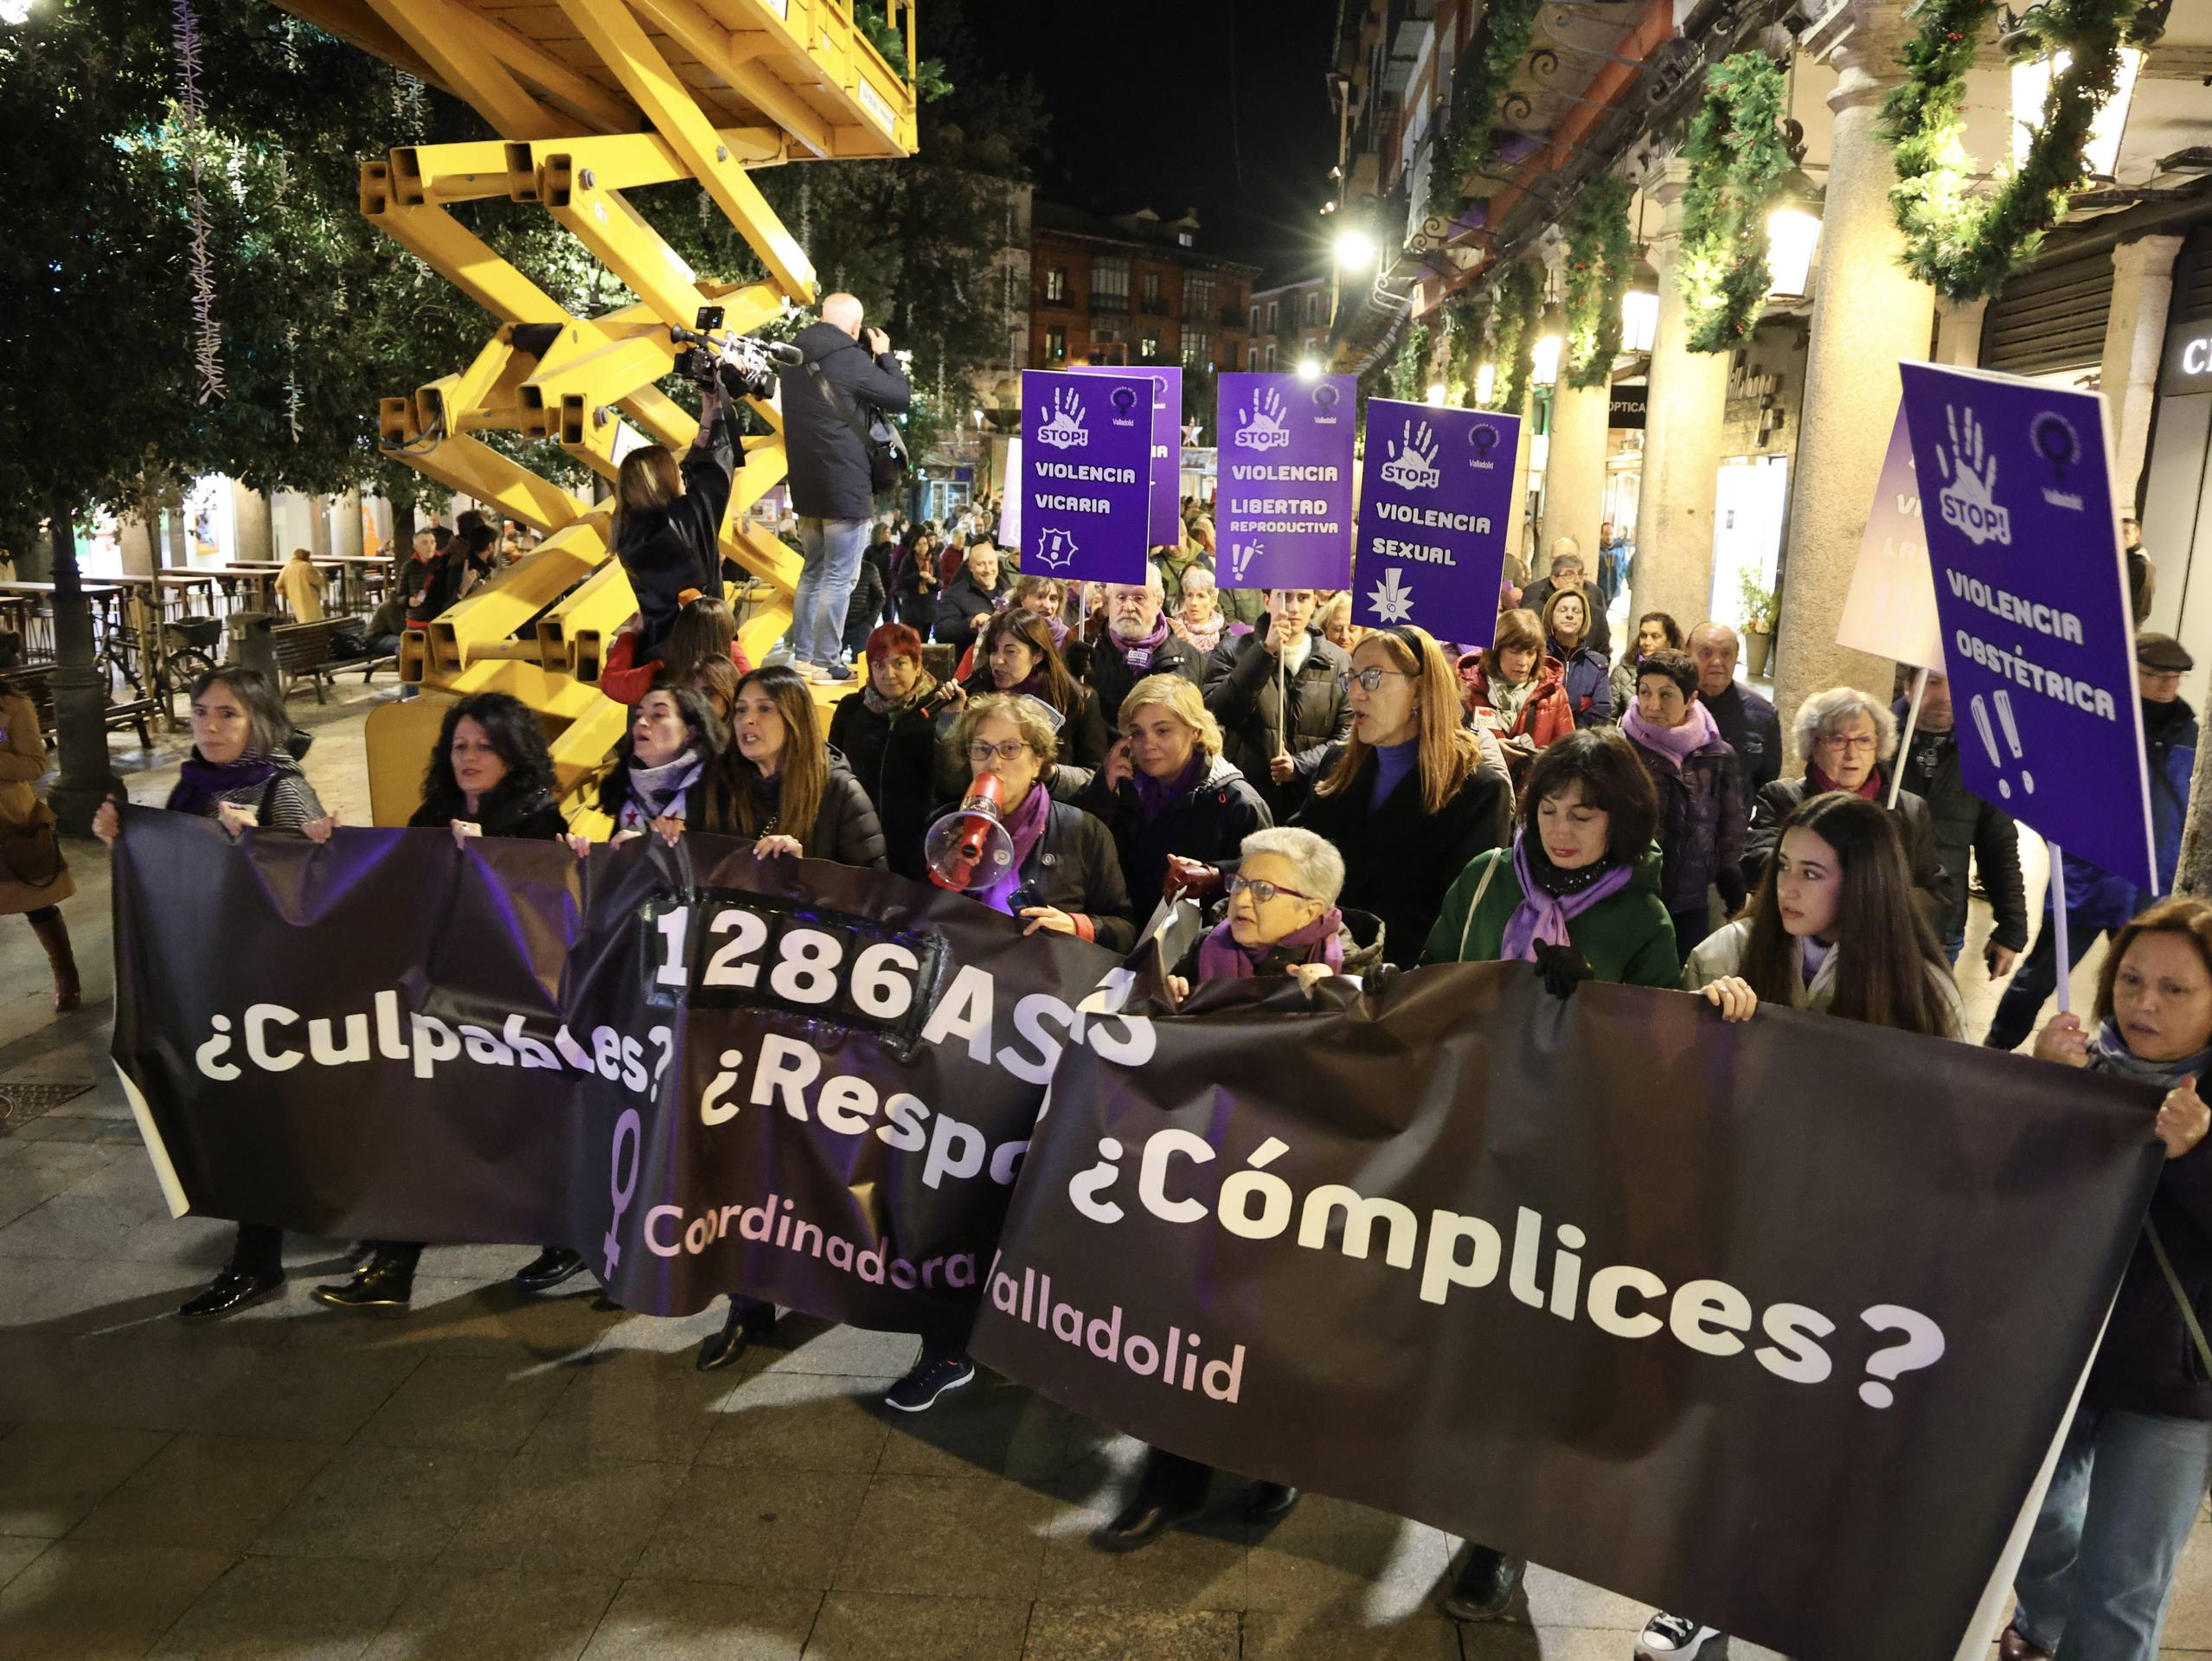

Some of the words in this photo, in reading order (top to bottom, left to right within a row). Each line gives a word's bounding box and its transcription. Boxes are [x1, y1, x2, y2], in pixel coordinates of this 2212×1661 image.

[1041, 429, 1086, 443] STOP!
[1238, 432, 1286, 444] STOP!
[1035, 462, 1136, 484] VIOLENCIA
[1232, 465, 1337, 482] VIOLENCIA
[1384, 465, 1437, 485] STOP!
[1035, 493, 1111, 514] VICARIA
[1231, 498, 1328, 515] LIBERTAD
[1375, 502, 1491, 534] VIOLENCIA
[1945, 494, 2009, 536] STOP!
[1230, 521, 1338, 534] REPRODUCTIVA
[1372, 537, 1457, 566] SEXUAL
[1946, 568, 2084, 645] VIOLENCIA
[1955, 630, 2116, 721] OBSTÉTRICA
[656, 906, 920, 1019] 1286
[196, 990, 673, 1103] ¿Culpables?
[1069, 1127, 1946, 1409] ¿Cómplices?
[644, 1195, 975, 1290] Coordinadora
[984, 1248, 1246, 1404] alladolid
